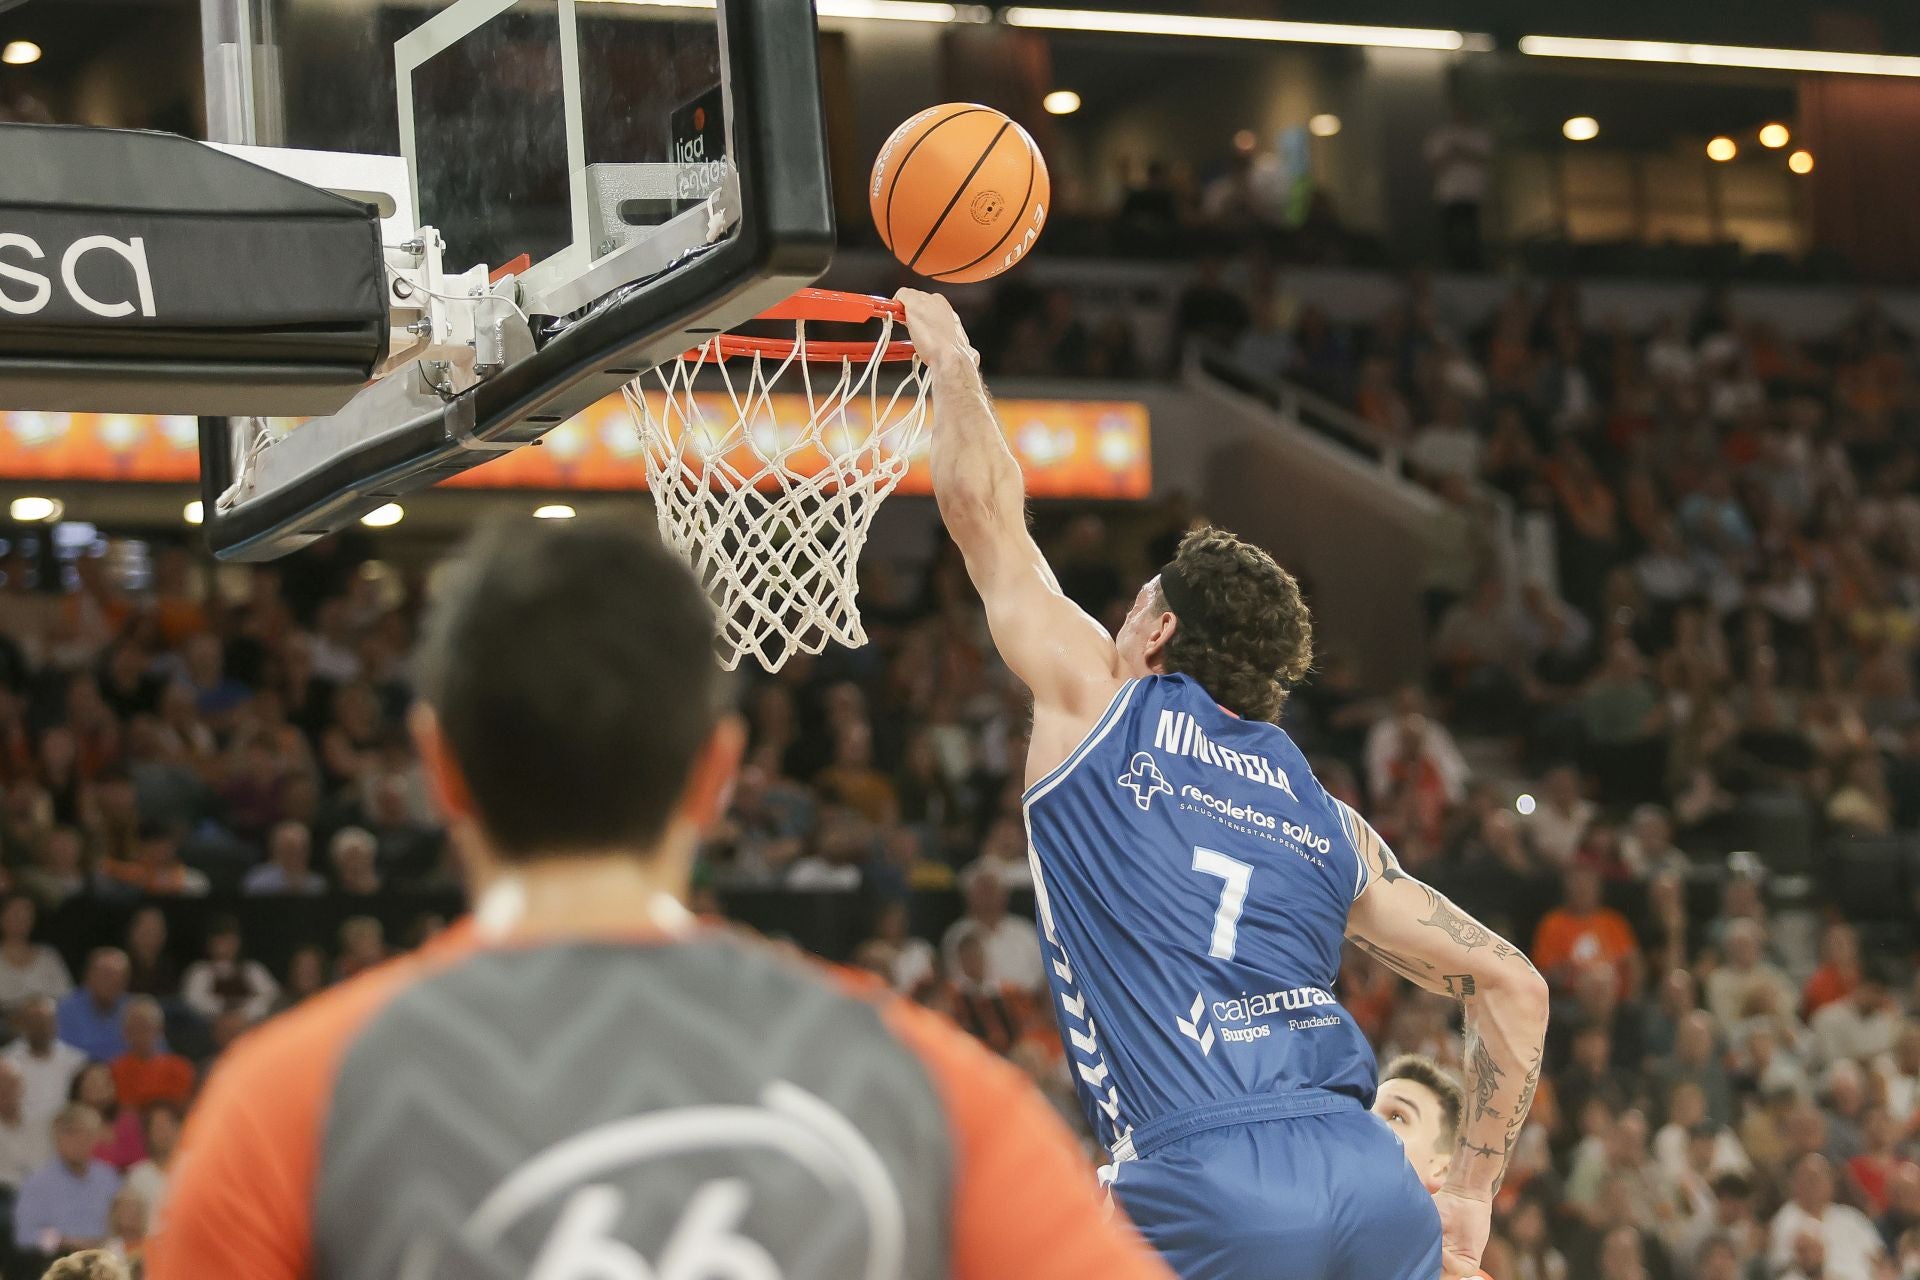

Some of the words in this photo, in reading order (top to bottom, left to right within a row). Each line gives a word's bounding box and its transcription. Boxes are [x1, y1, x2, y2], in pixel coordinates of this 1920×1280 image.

[676, 134, 704, 170] liga
[680, 153, 728, 199] endes
[1181, 785, 1276, 830] recoletas
[1282, 821, 1331, 855] salud
[1191, 845, 1255, 961] 7
[1220, 1023, 1271, 1042] Burgos
[1288, 1014, 1341, 1031] Fundación
